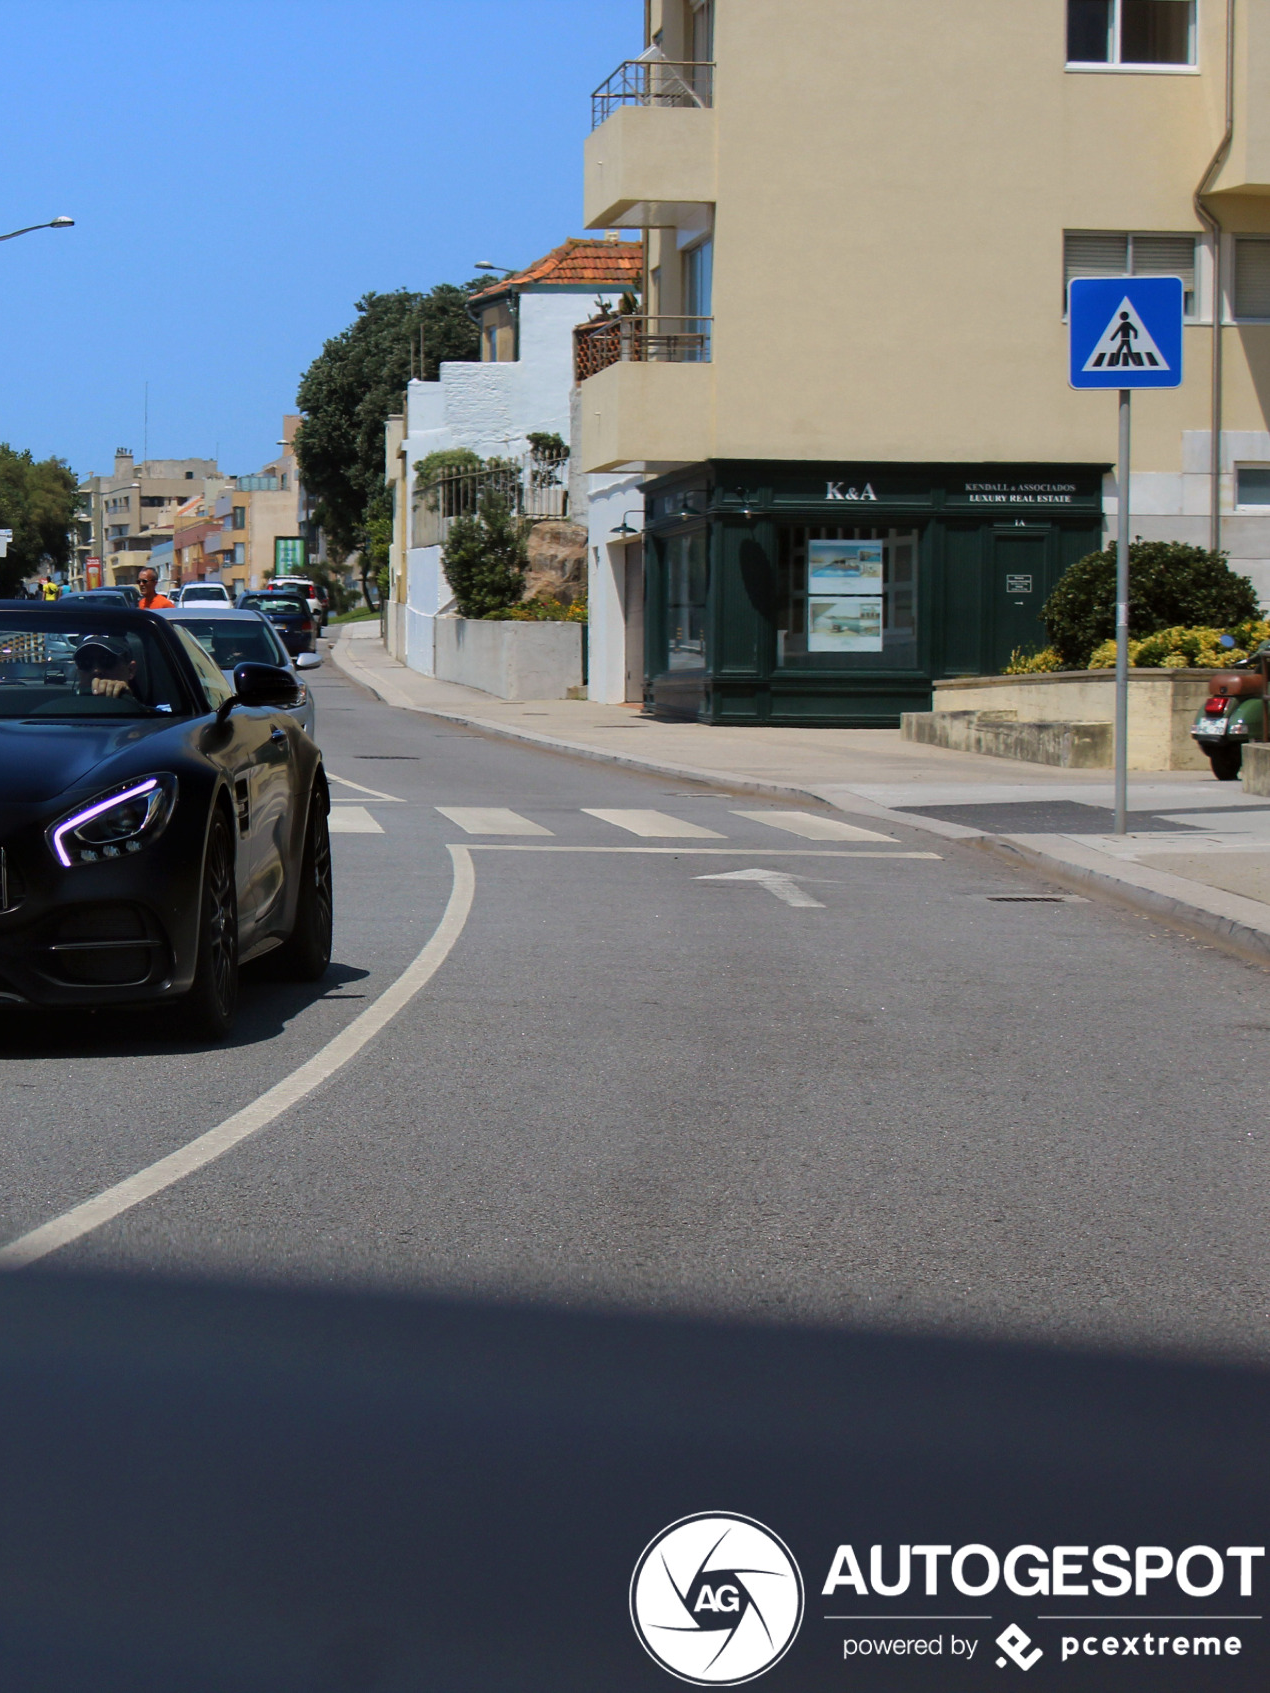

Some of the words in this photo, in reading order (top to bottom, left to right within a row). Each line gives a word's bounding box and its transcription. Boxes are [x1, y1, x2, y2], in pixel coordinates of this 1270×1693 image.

[825, 481, 878, 501] K&A
[965, 483, 1009, 492] KENDALL
[1017, 484, 1076, 492] ASSOCIADOS
[969, 494, 1007, 502] LUXURY
[1009, 495, 1035, 503] REAL
[1037, 495, 1072, 503] ESTATE
